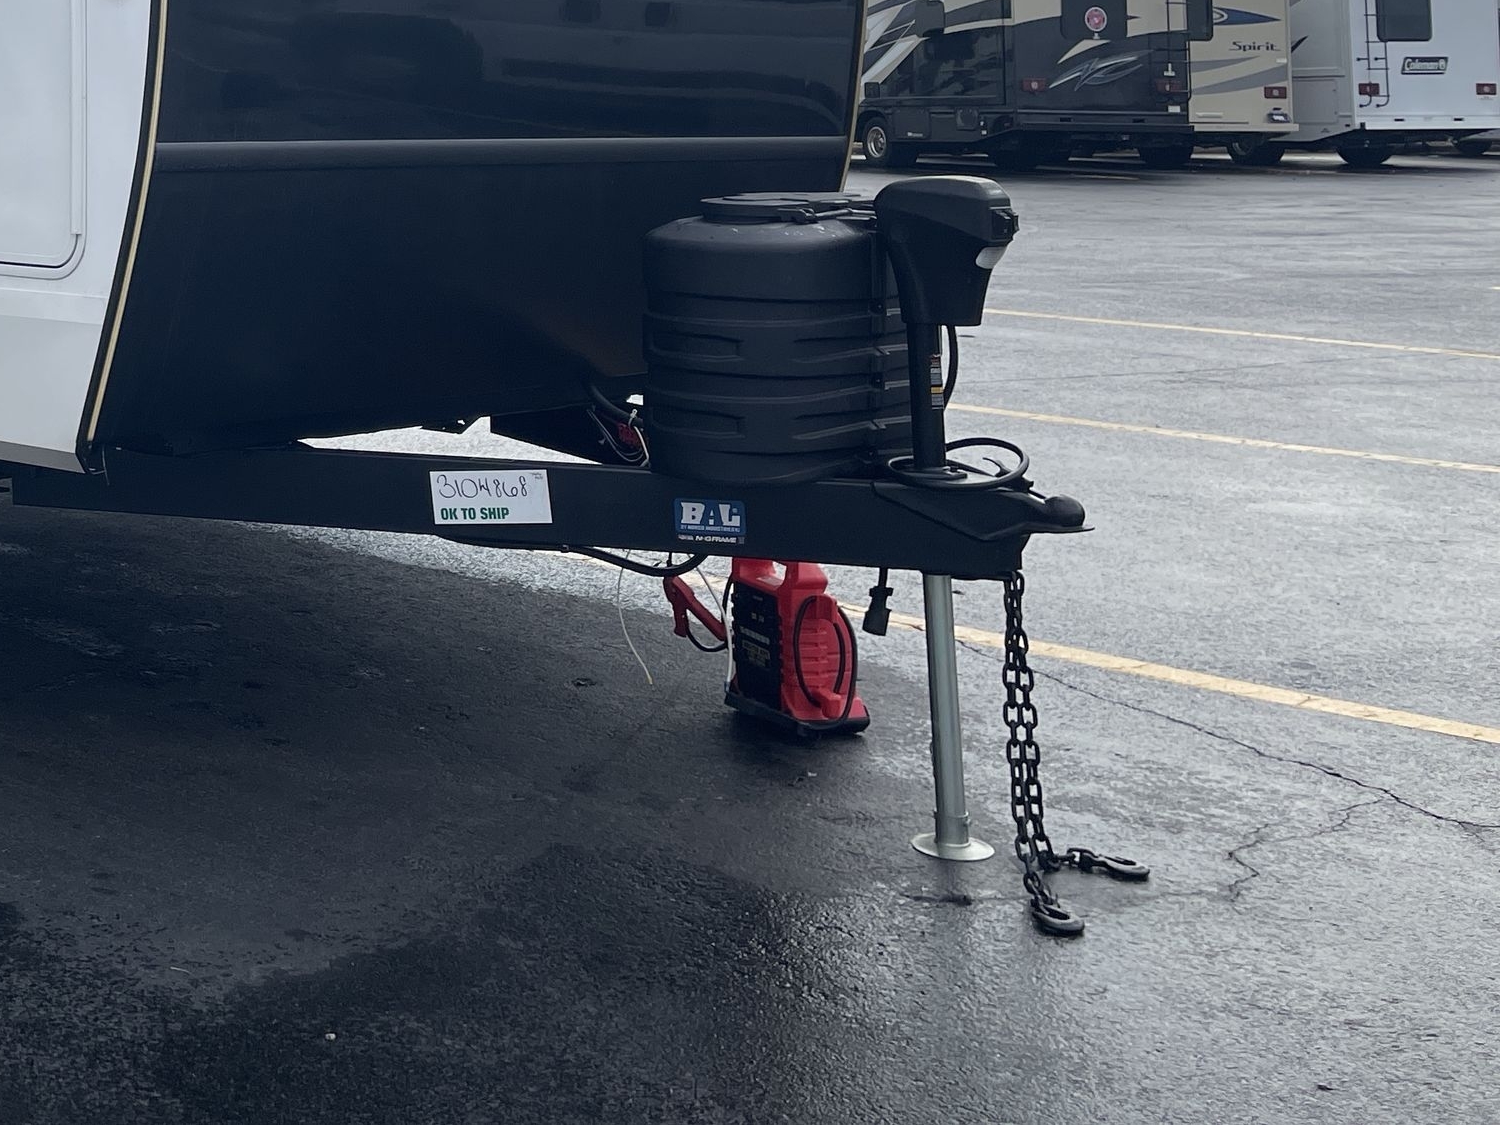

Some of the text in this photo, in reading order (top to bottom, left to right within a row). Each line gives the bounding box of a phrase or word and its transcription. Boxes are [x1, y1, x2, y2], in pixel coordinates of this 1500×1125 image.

[1229, 41, 1281, 52] Spirit
[436, 474, 528, 499] 3104868
[440, 507, 510, 521] OK TO SHIP
[680, 501, 741, 527] BAL
